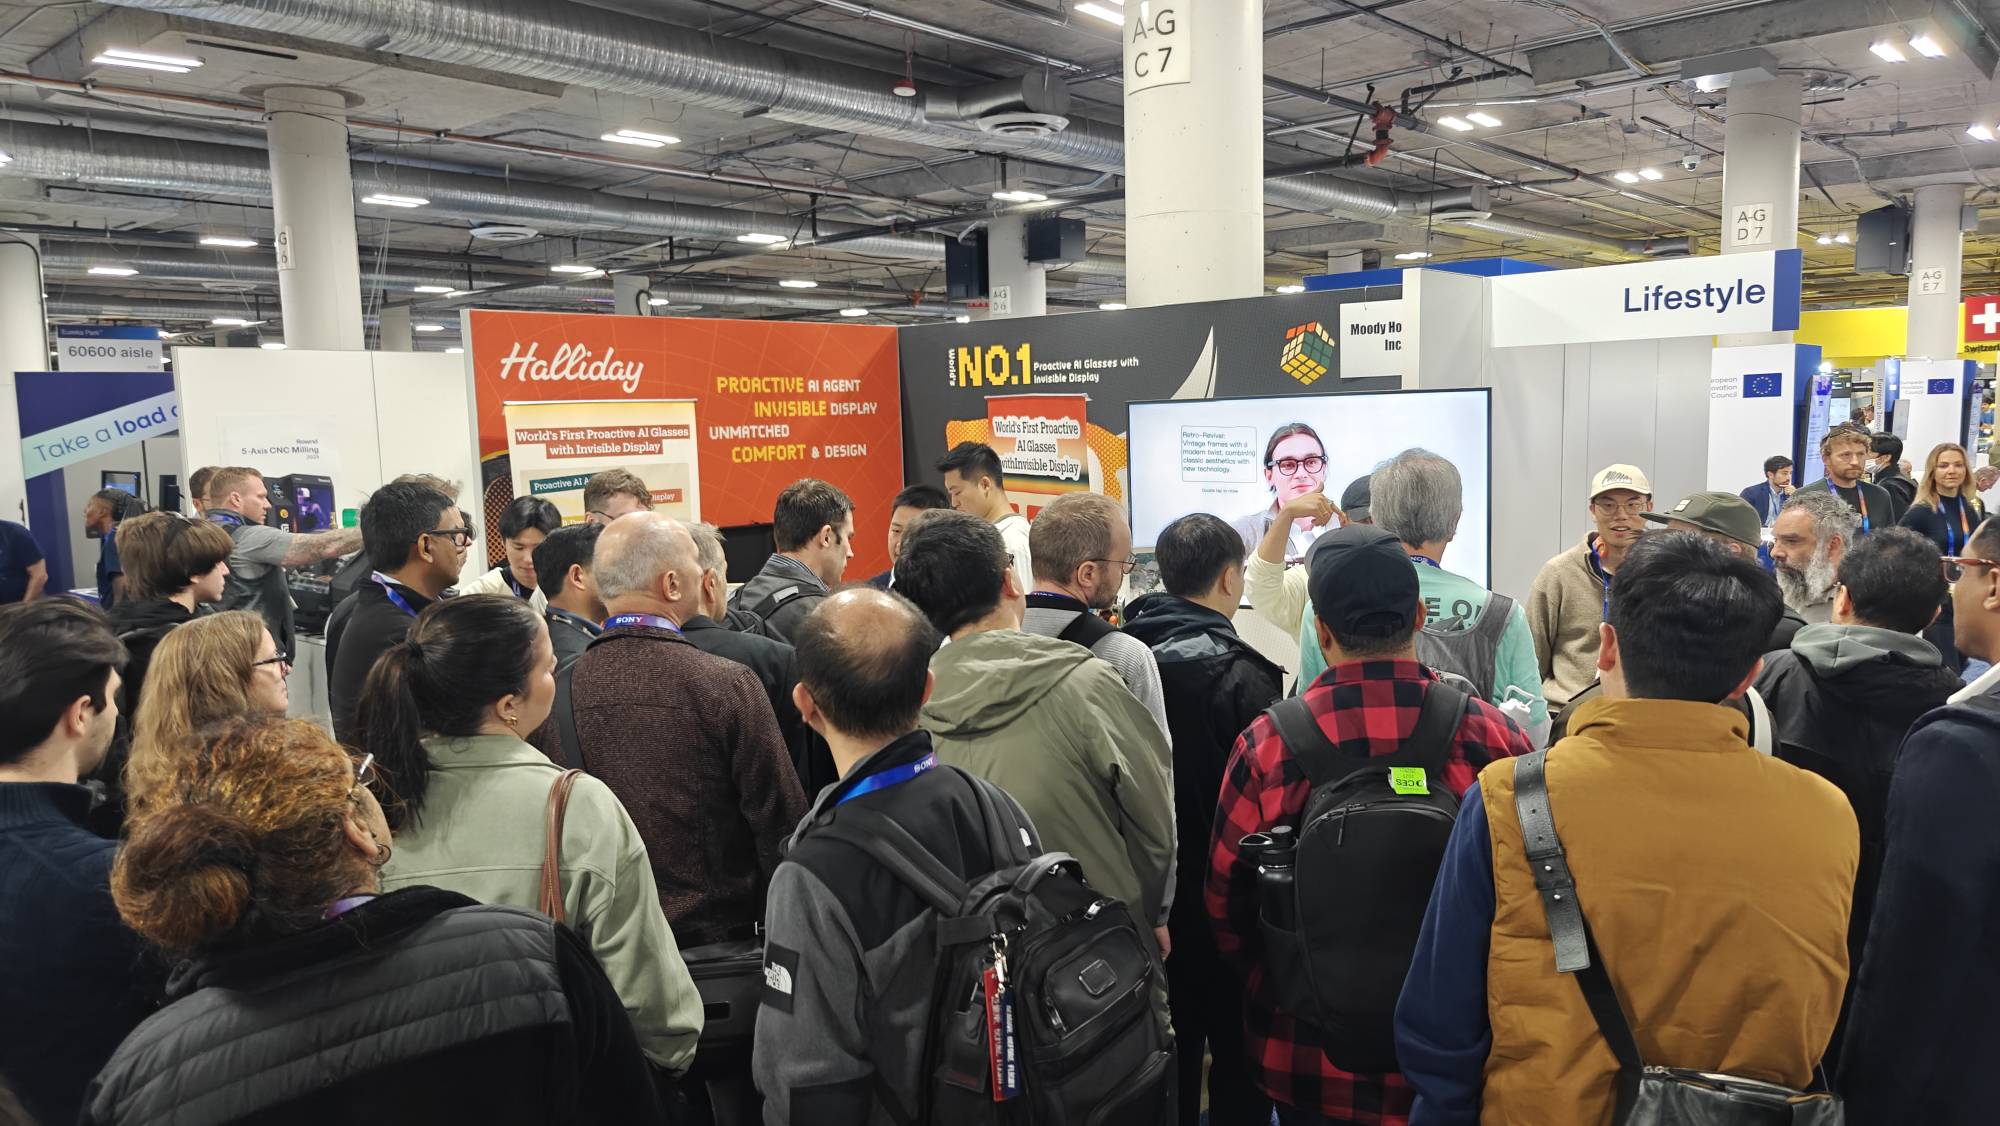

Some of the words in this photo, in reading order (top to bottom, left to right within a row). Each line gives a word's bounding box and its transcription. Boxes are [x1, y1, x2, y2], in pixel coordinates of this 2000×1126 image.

[1132, 9, 1176, 43] A-G
[1134, 52, 1149, 77] C
[1157, 46, 1172, 73] 7
[1737, 209, 1766, 223] A-G
[1737, 228, 1749, 240] D
[1754, 226, 1764, 239] 7
[1922, 270, 1942, 280] A-G
[1922, 282, 1930, 292] E
[1932, 282, 1940, 291] 7
[1623, 278, 1766, 314] Lifestyle
[1350, 322, 1386, 336] Moody
[1388, 321, 1402, 333] Ho
[68, 346, 117, 358] 60600
[121, 347, 153, 358] aisle
[1384, 339, 1402, 351] Inc
[500, 341, 645, 394] Halliday
[958, 343, 1031, 387] NO.1
[1033, 362, 1072, 372] Proactive
[1074, 360, 1082, 369] AI
[1084, 359, 1118, 369] Glasses
[1120, 356, 1139, 367] with
[716, 376, 804, 393] PROACTIVE
[808, 380, 820, 392] AI
[823, 379, 861, 392] AGENT
[1033, 374, 1067, 384] Invisible
[1069, 372, 1100, 383] Display
[754, 400, 827, 417] INVISIBLE
[830, 402, 878, 415] DISPLAY
[33, 434, 90, 462] Take
[95, 429, 111, 442] a
[113, 406, 167, 436] load
[516, 430, 558, 442] World's
[560, 429, 585, 441] First
[587, 428, 636, 440] Proactive
[650, 426, 689, 437] Glasses
[709, 424, 790, 439] UNMATCHED
[994, 421, 1021, 433] World's
[1022, 421, 1039, 434] First
[1040, 422, 1079, 435] Proactive
[241, 447, 268, 455] 5-Axis
[269, 446, 290, 454] CNC
[291, 446, 320, 455] Milling
[549, 444, 575, 456] with
[576, 443, 621, 455] Invisible
[622, 441, 661, 454] Display
[1017, 440, 1026, 452] AI
[1027, 440, 1057, 453] Glasses
[1183, 440, 1206, 448] Vintage
[731, 444, 806, 463] COMFORT
[811, 447, 820, 459] &
[824, 444, 867, 458] DESIGN
[1049, 460, 1079, 476] Display
[534, 480, 572, 491] Proactive
[573, 478, 583, 486] AI
[615, 616, 643, 624] SONY
[914, 757, 934, 774] SONY
